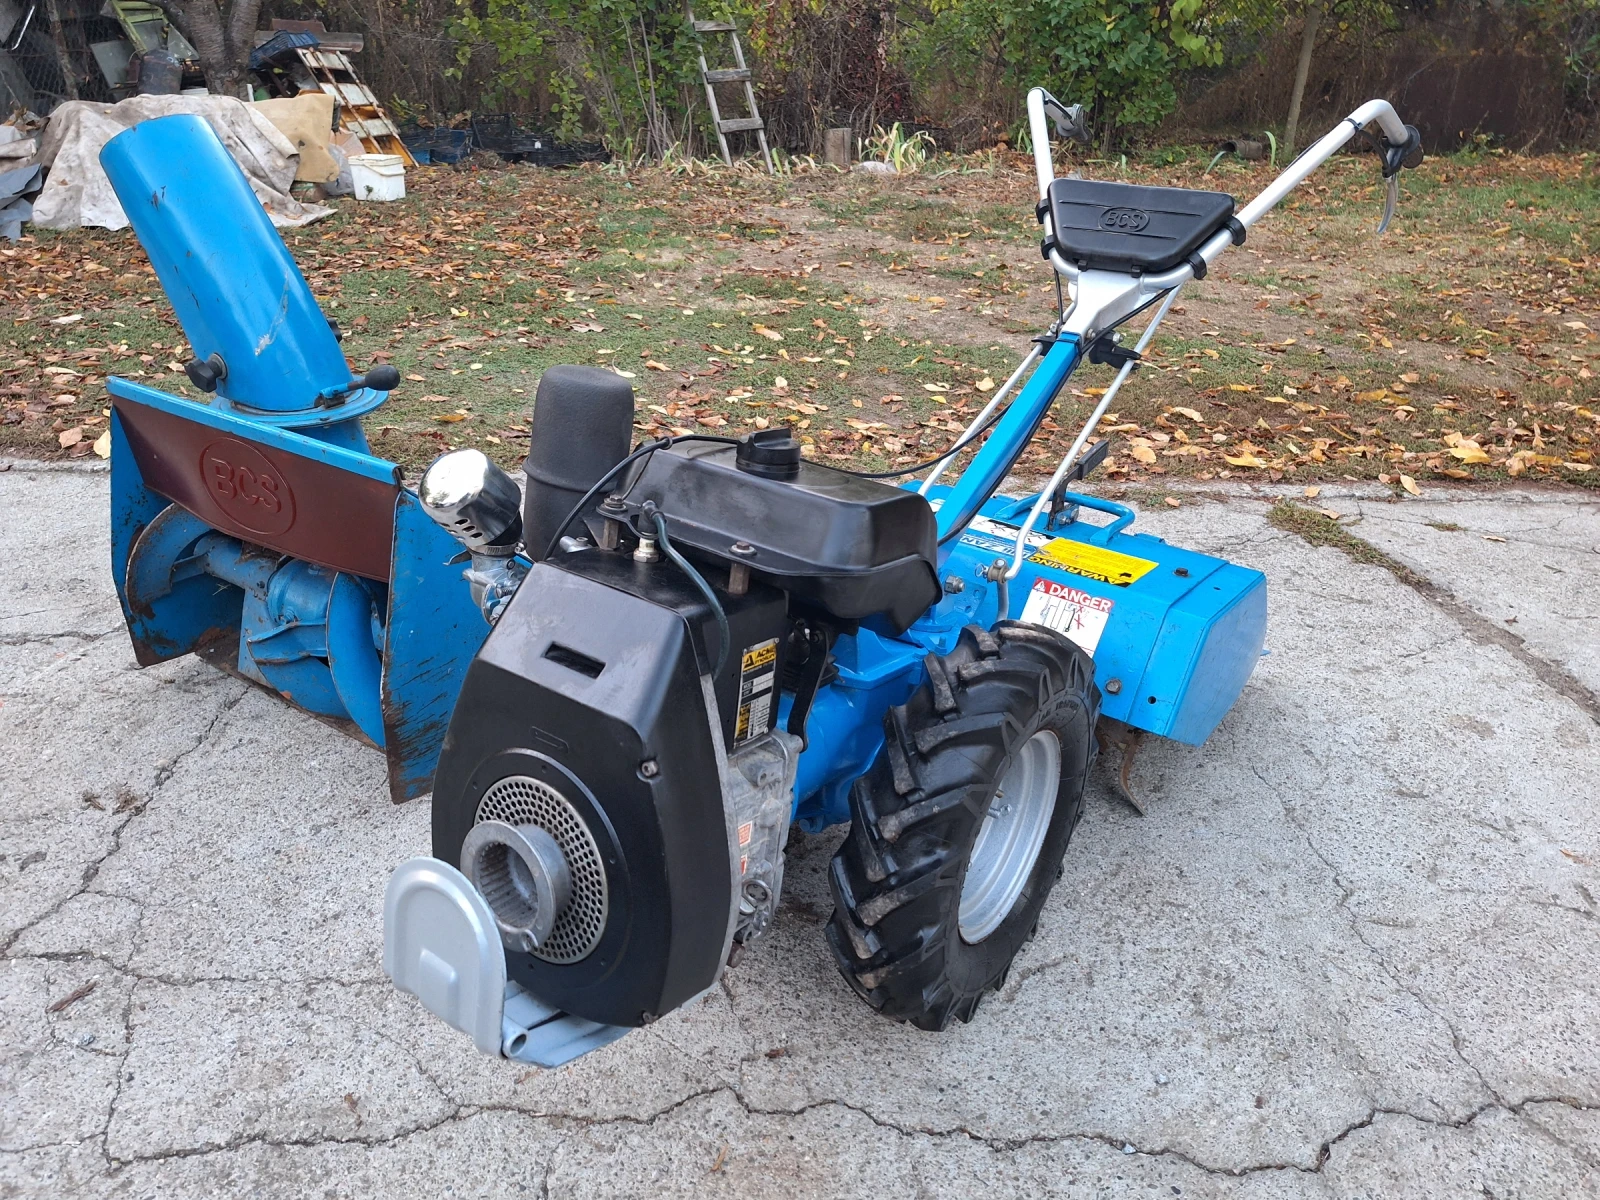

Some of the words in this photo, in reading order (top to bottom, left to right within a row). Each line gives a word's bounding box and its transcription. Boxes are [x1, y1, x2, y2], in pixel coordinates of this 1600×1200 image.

[1104, 211, 1143, 229] BCS
[210, 456, 282, 515] BCS
[1028, 555, 1106, 582] WARNING
[1048, 583, 1112, 613] DANGER
